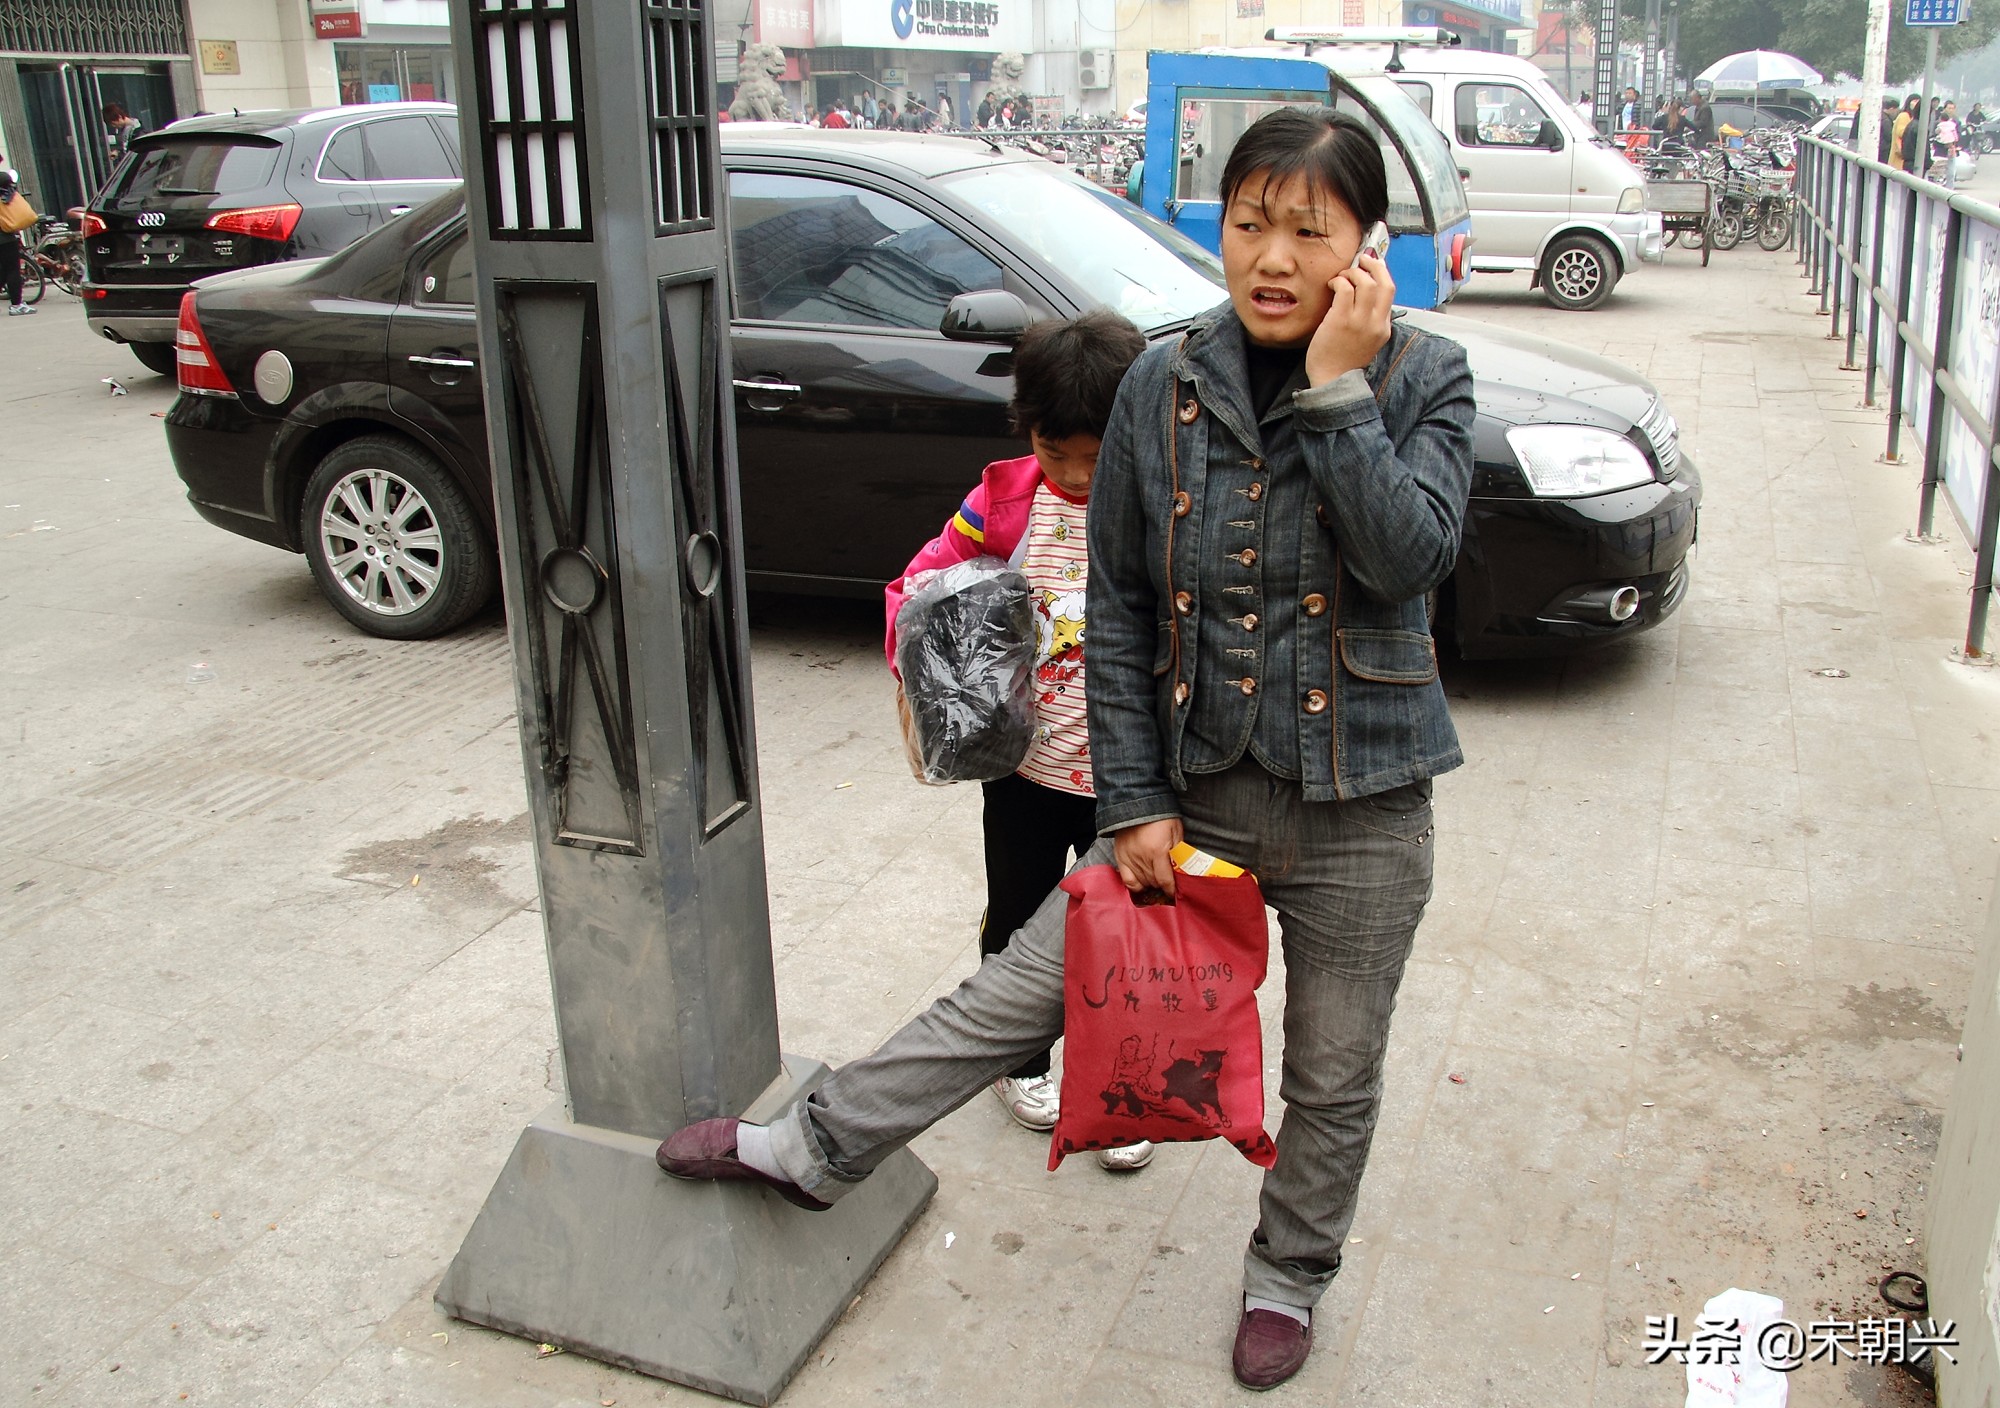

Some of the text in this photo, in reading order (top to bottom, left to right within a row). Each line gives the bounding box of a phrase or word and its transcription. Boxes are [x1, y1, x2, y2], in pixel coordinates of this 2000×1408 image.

[916, 0, 999, 25] 中国建设银行
[1911, 10, 1954, 20] 注意安全
[917, 22, 990, 37] China Construction Bank
